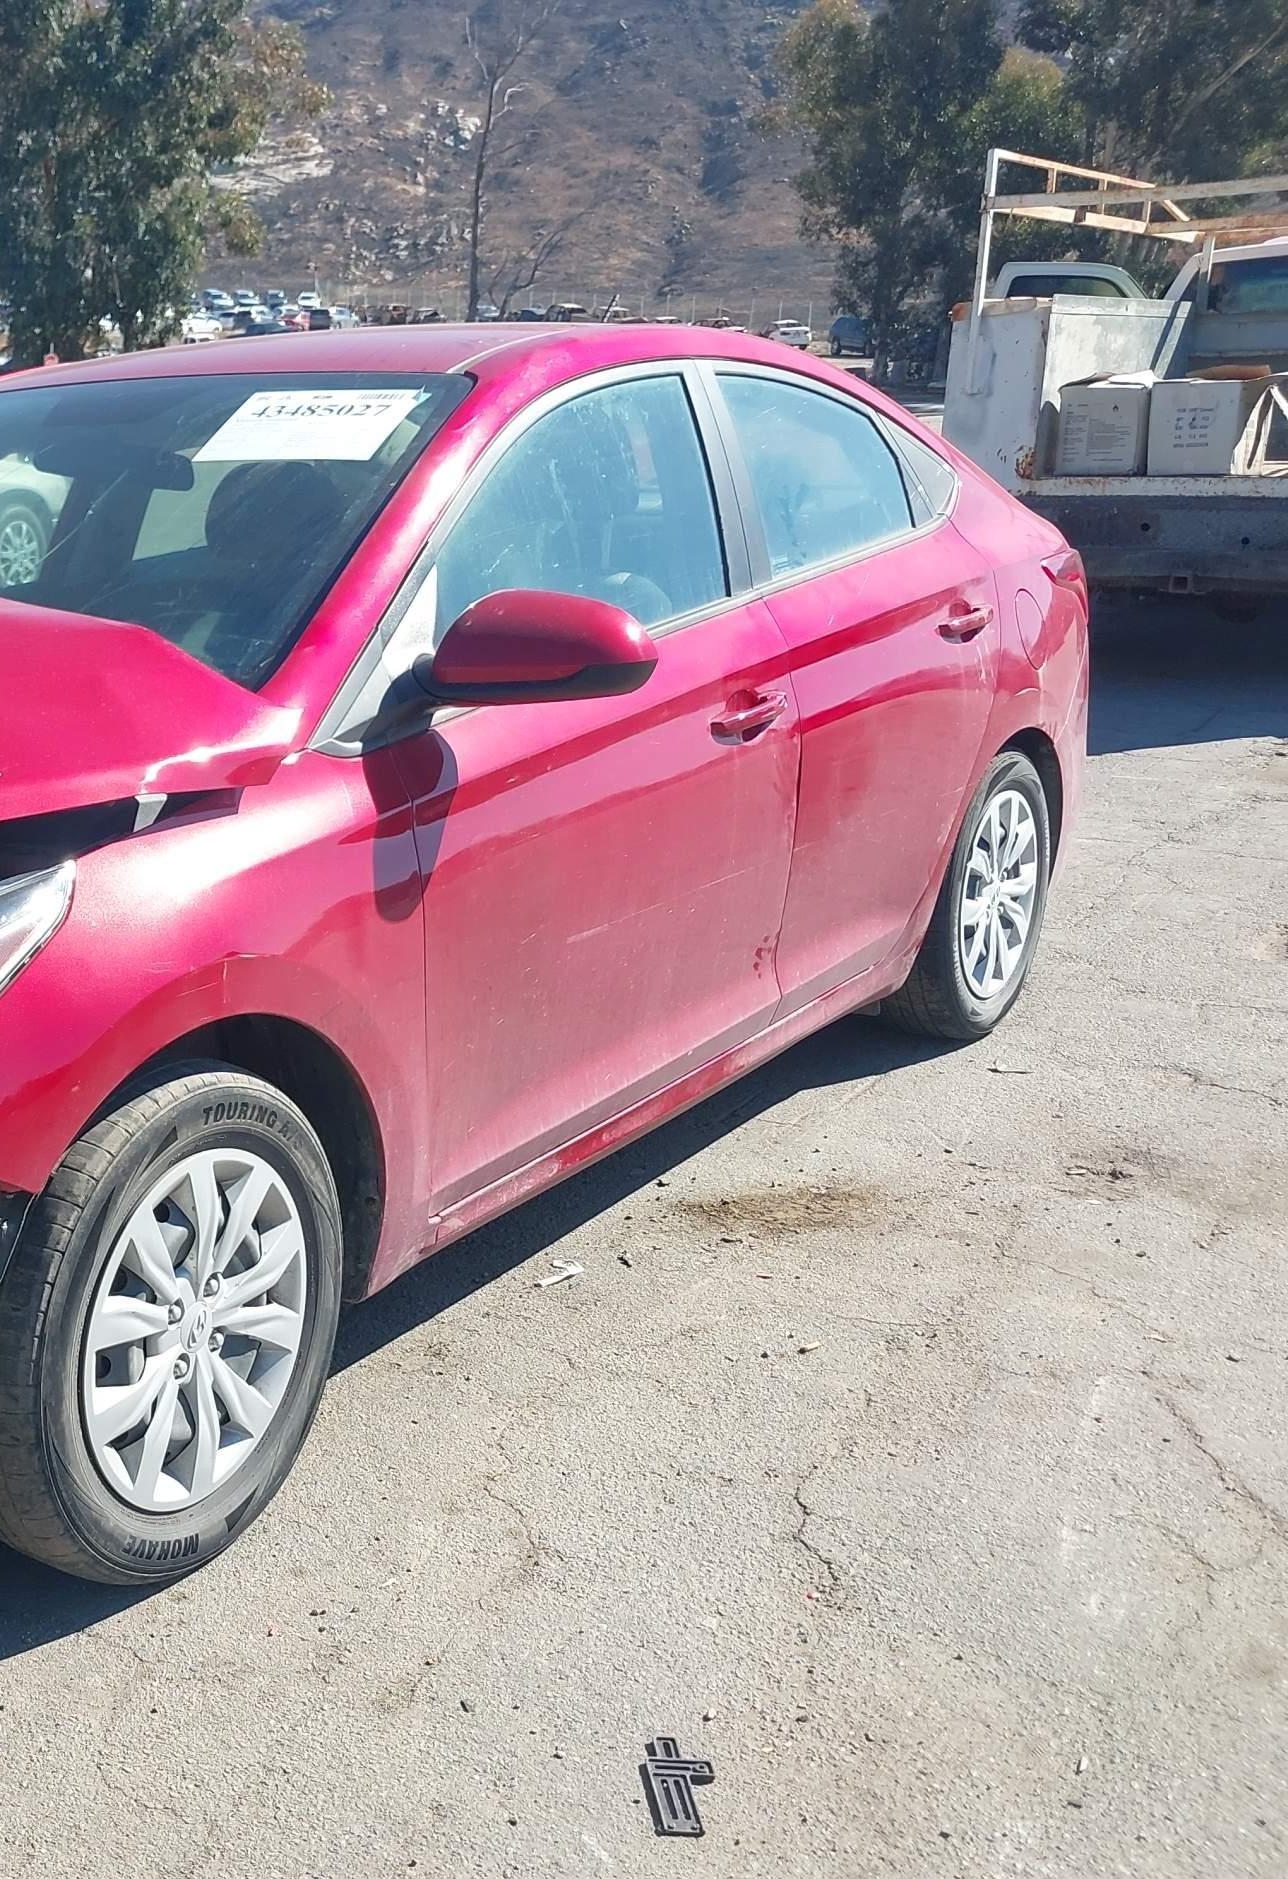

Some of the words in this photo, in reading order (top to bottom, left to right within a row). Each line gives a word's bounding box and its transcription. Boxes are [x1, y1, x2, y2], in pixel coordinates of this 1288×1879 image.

[251, 404, 392, 418] 43485027
[203, 1102, 278, 1129] TOURING
[120, 1533, 200, 1561] MOHAVE
